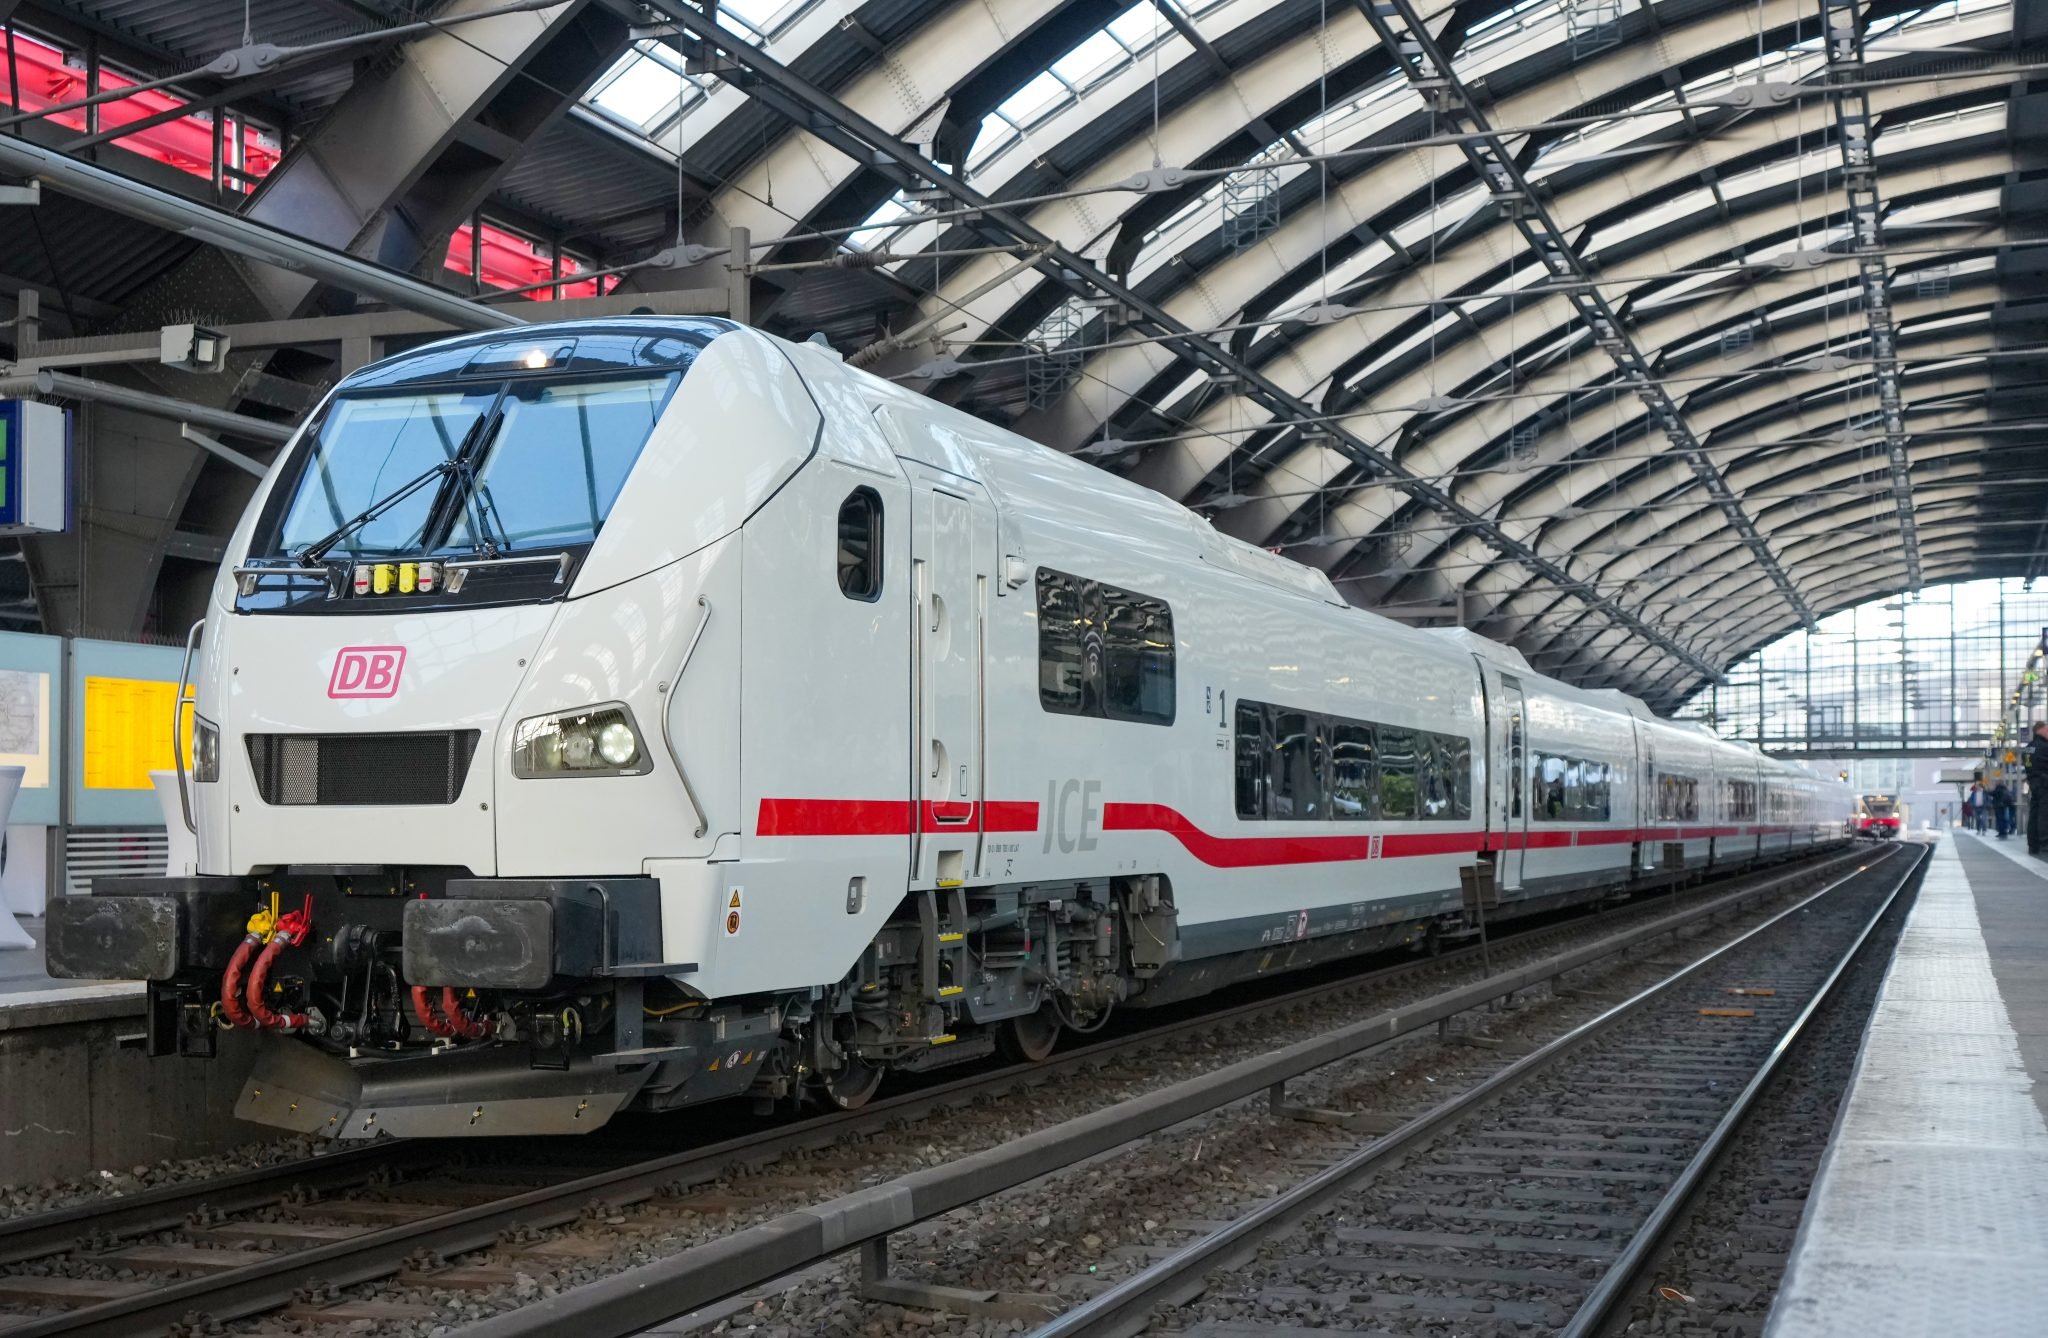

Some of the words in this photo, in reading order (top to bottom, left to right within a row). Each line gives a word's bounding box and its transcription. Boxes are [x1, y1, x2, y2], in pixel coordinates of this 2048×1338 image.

[337, 653, 396, 691] DB
[1219, 689, 1228, 729] 1
[1042, 778, 1102, 855] ICE
